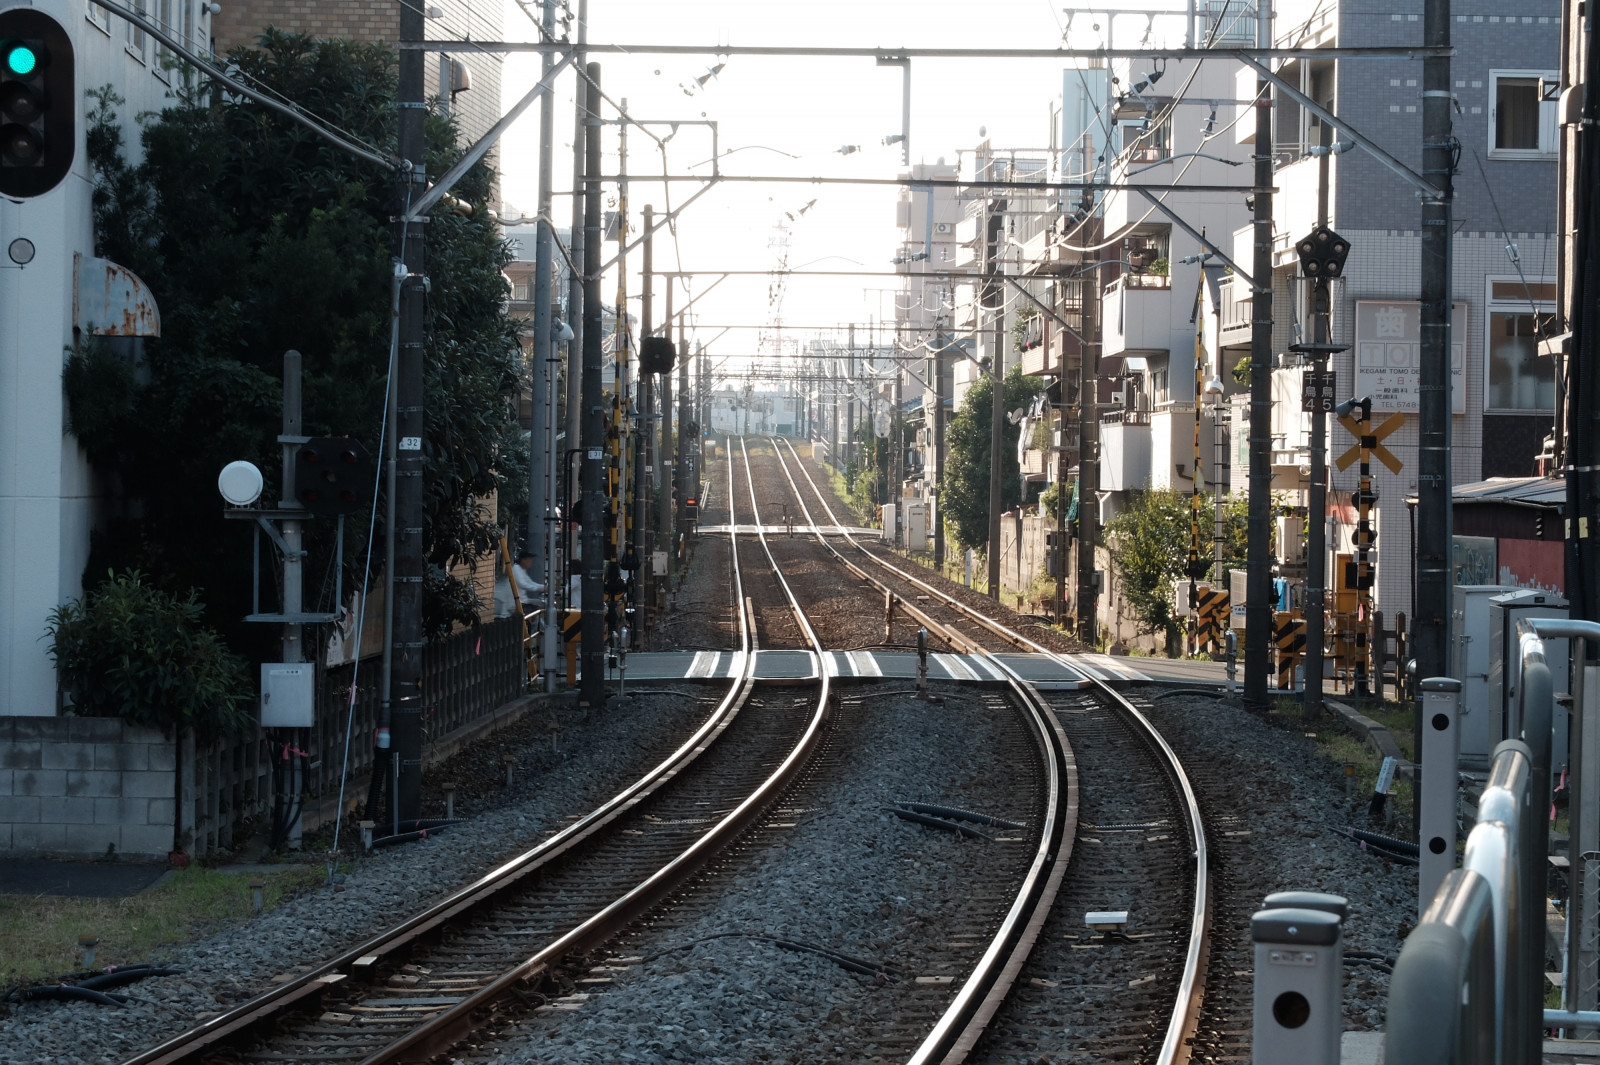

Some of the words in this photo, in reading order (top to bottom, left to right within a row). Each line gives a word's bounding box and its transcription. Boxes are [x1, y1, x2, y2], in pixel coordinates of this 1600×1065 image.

[1305, 373, 1317, 410] 千鳥4
[1321, 373, 1333, 410] 千鳥5
[407, 438, 417, 446] 32
